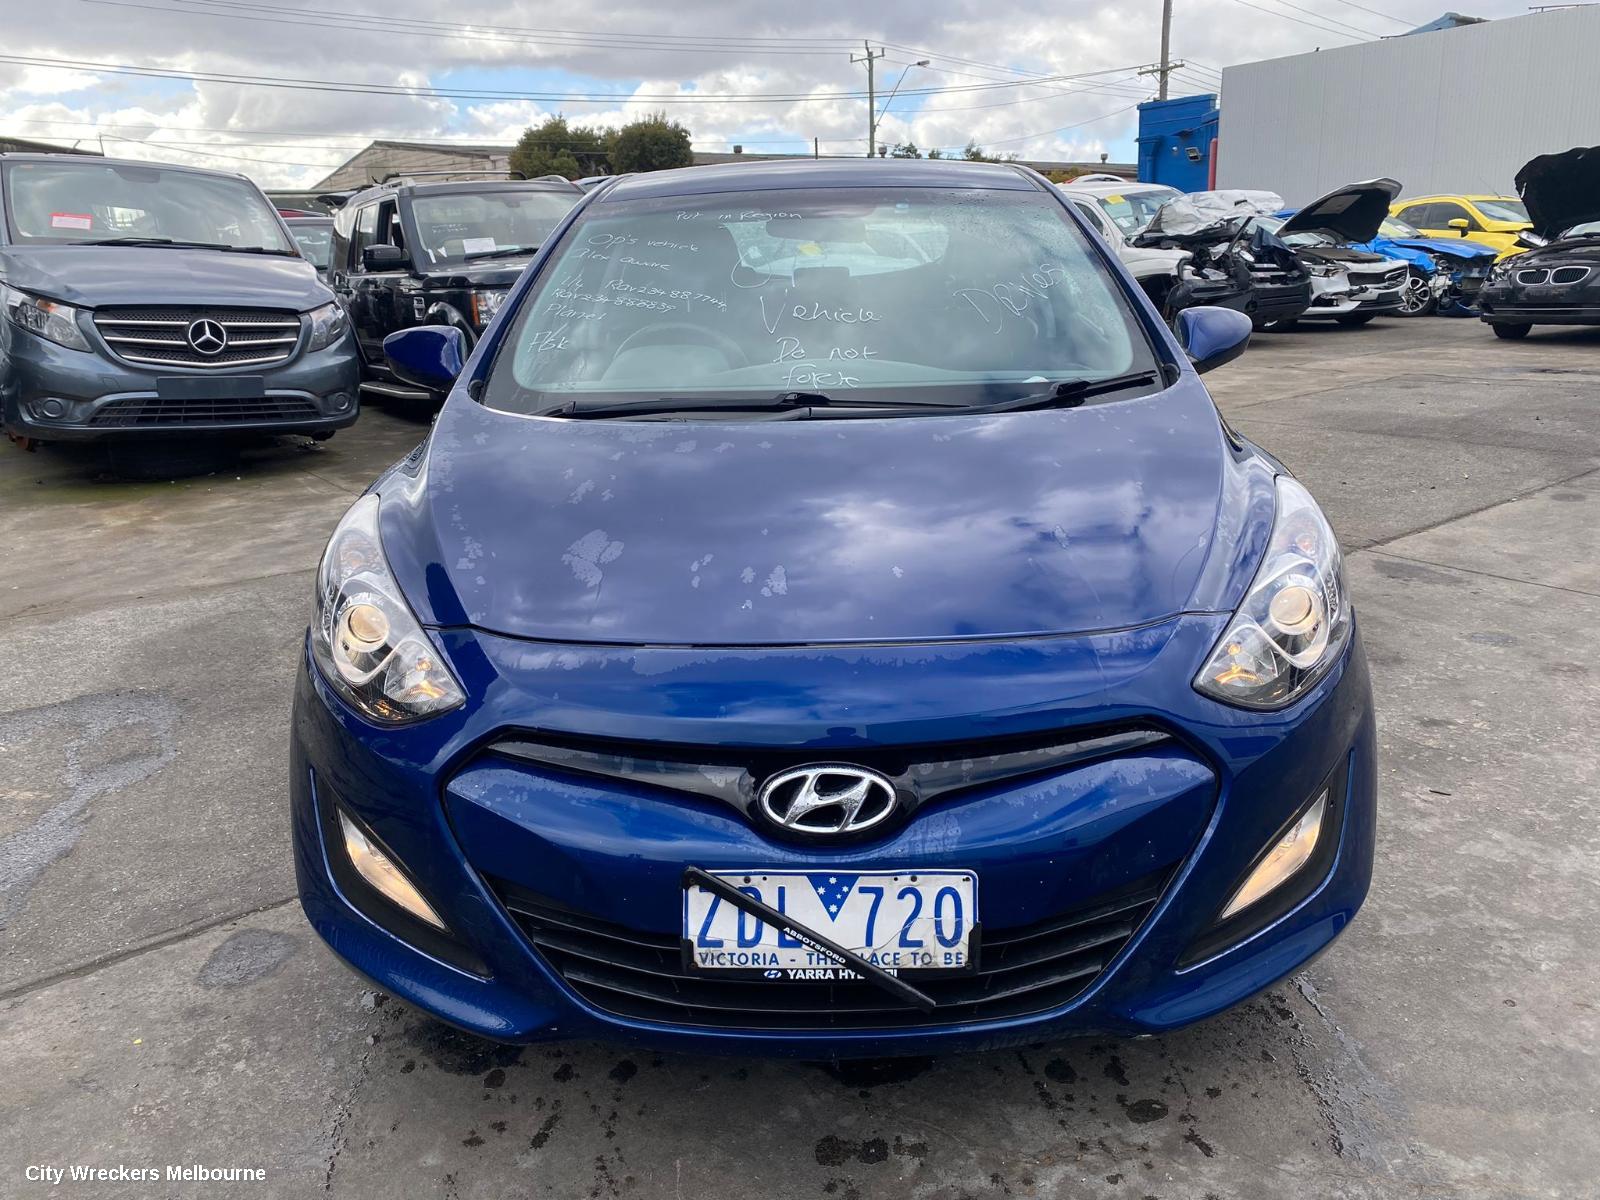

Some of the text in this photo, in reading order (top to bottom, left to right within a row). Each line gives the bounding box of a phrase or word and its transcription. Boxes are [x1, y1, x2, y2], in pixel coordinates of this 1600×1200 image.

[697, 886, 963, 949] ZDL 720
[783, 927, 846, 964] ABBOTSFORD
[699, 952, 780, 966] VICTORIA
[860, 952, 900, 966] ACE
[911, 952, 933, 966] TO
[943, 952, 963, 966] BE
[787, 969, 834, 980] YARRA
